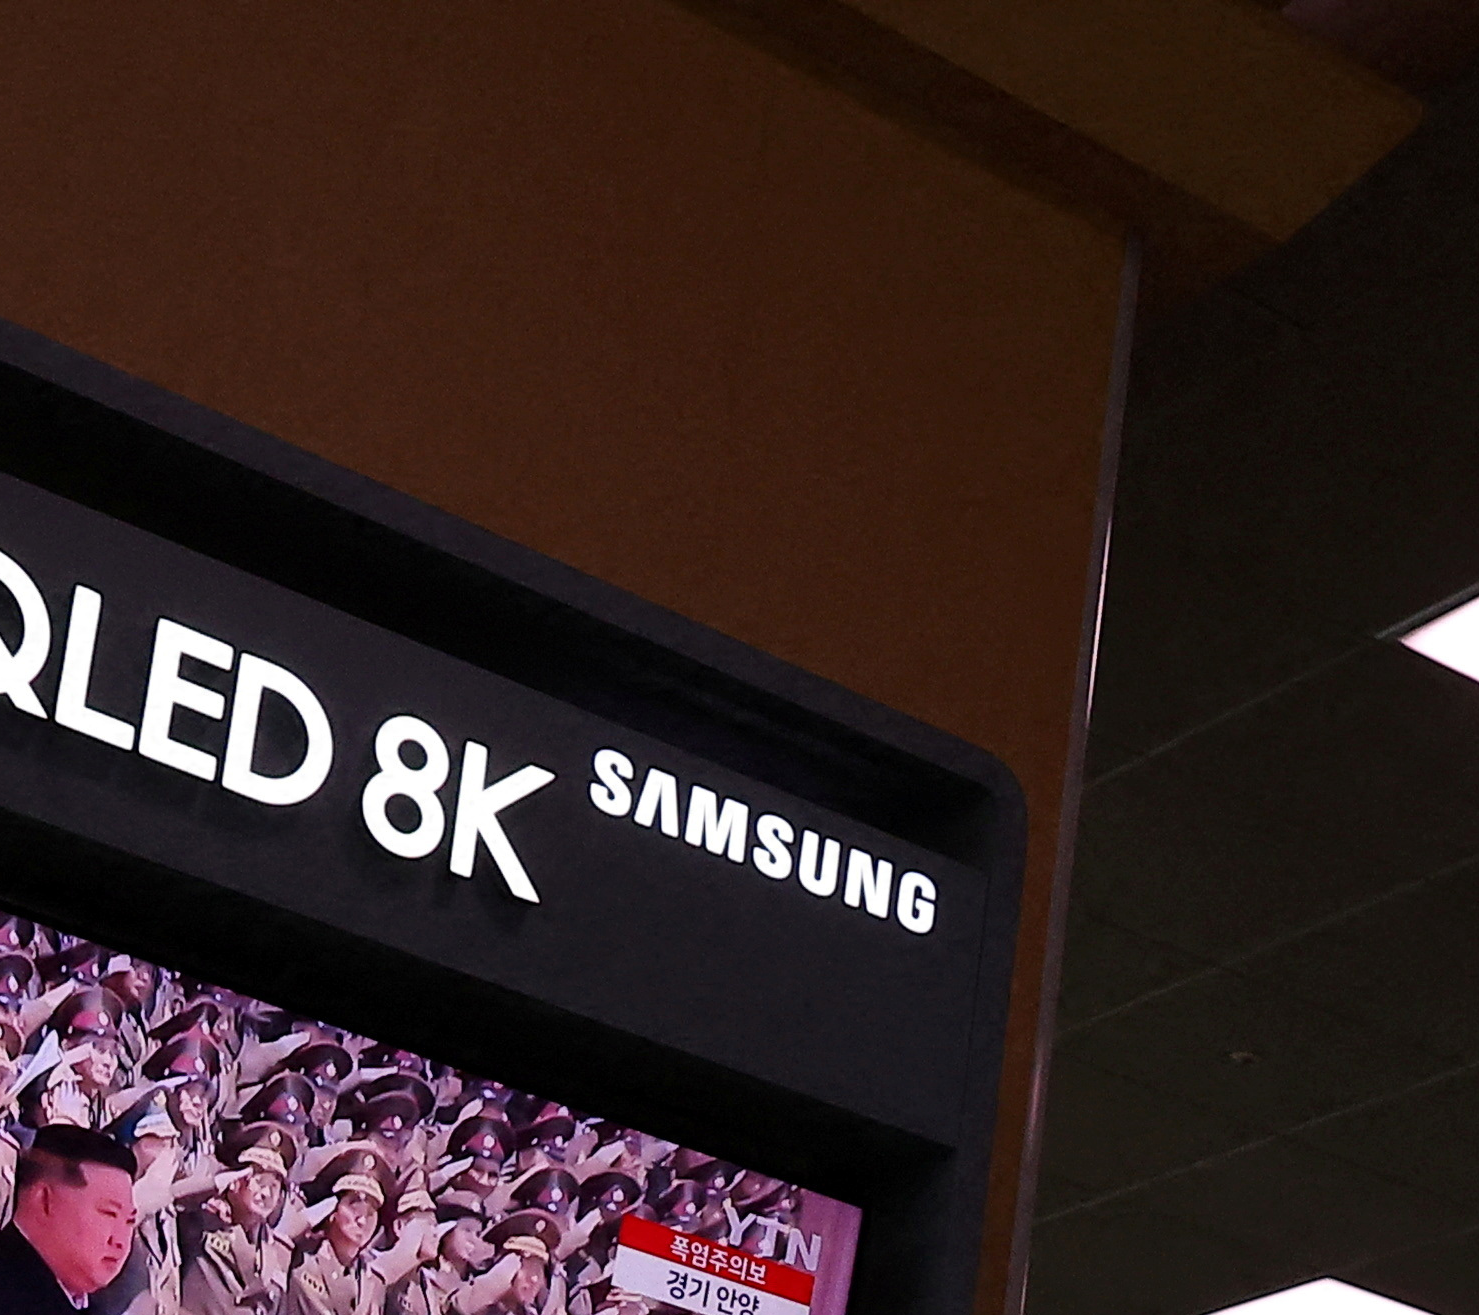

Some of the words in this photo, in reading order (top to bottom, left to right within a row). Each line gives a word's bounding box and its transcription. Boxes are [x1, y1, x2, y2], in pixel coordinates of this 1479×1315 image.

[360, 714, 556, 904] 8K
[589, 746, 937, 934] SAMSUNG
[669, 1234, 767, 1285] 폭염주의보
[723, 1197, 822, 1272] YTN
[666, 1270, 711, 1308] 경기
